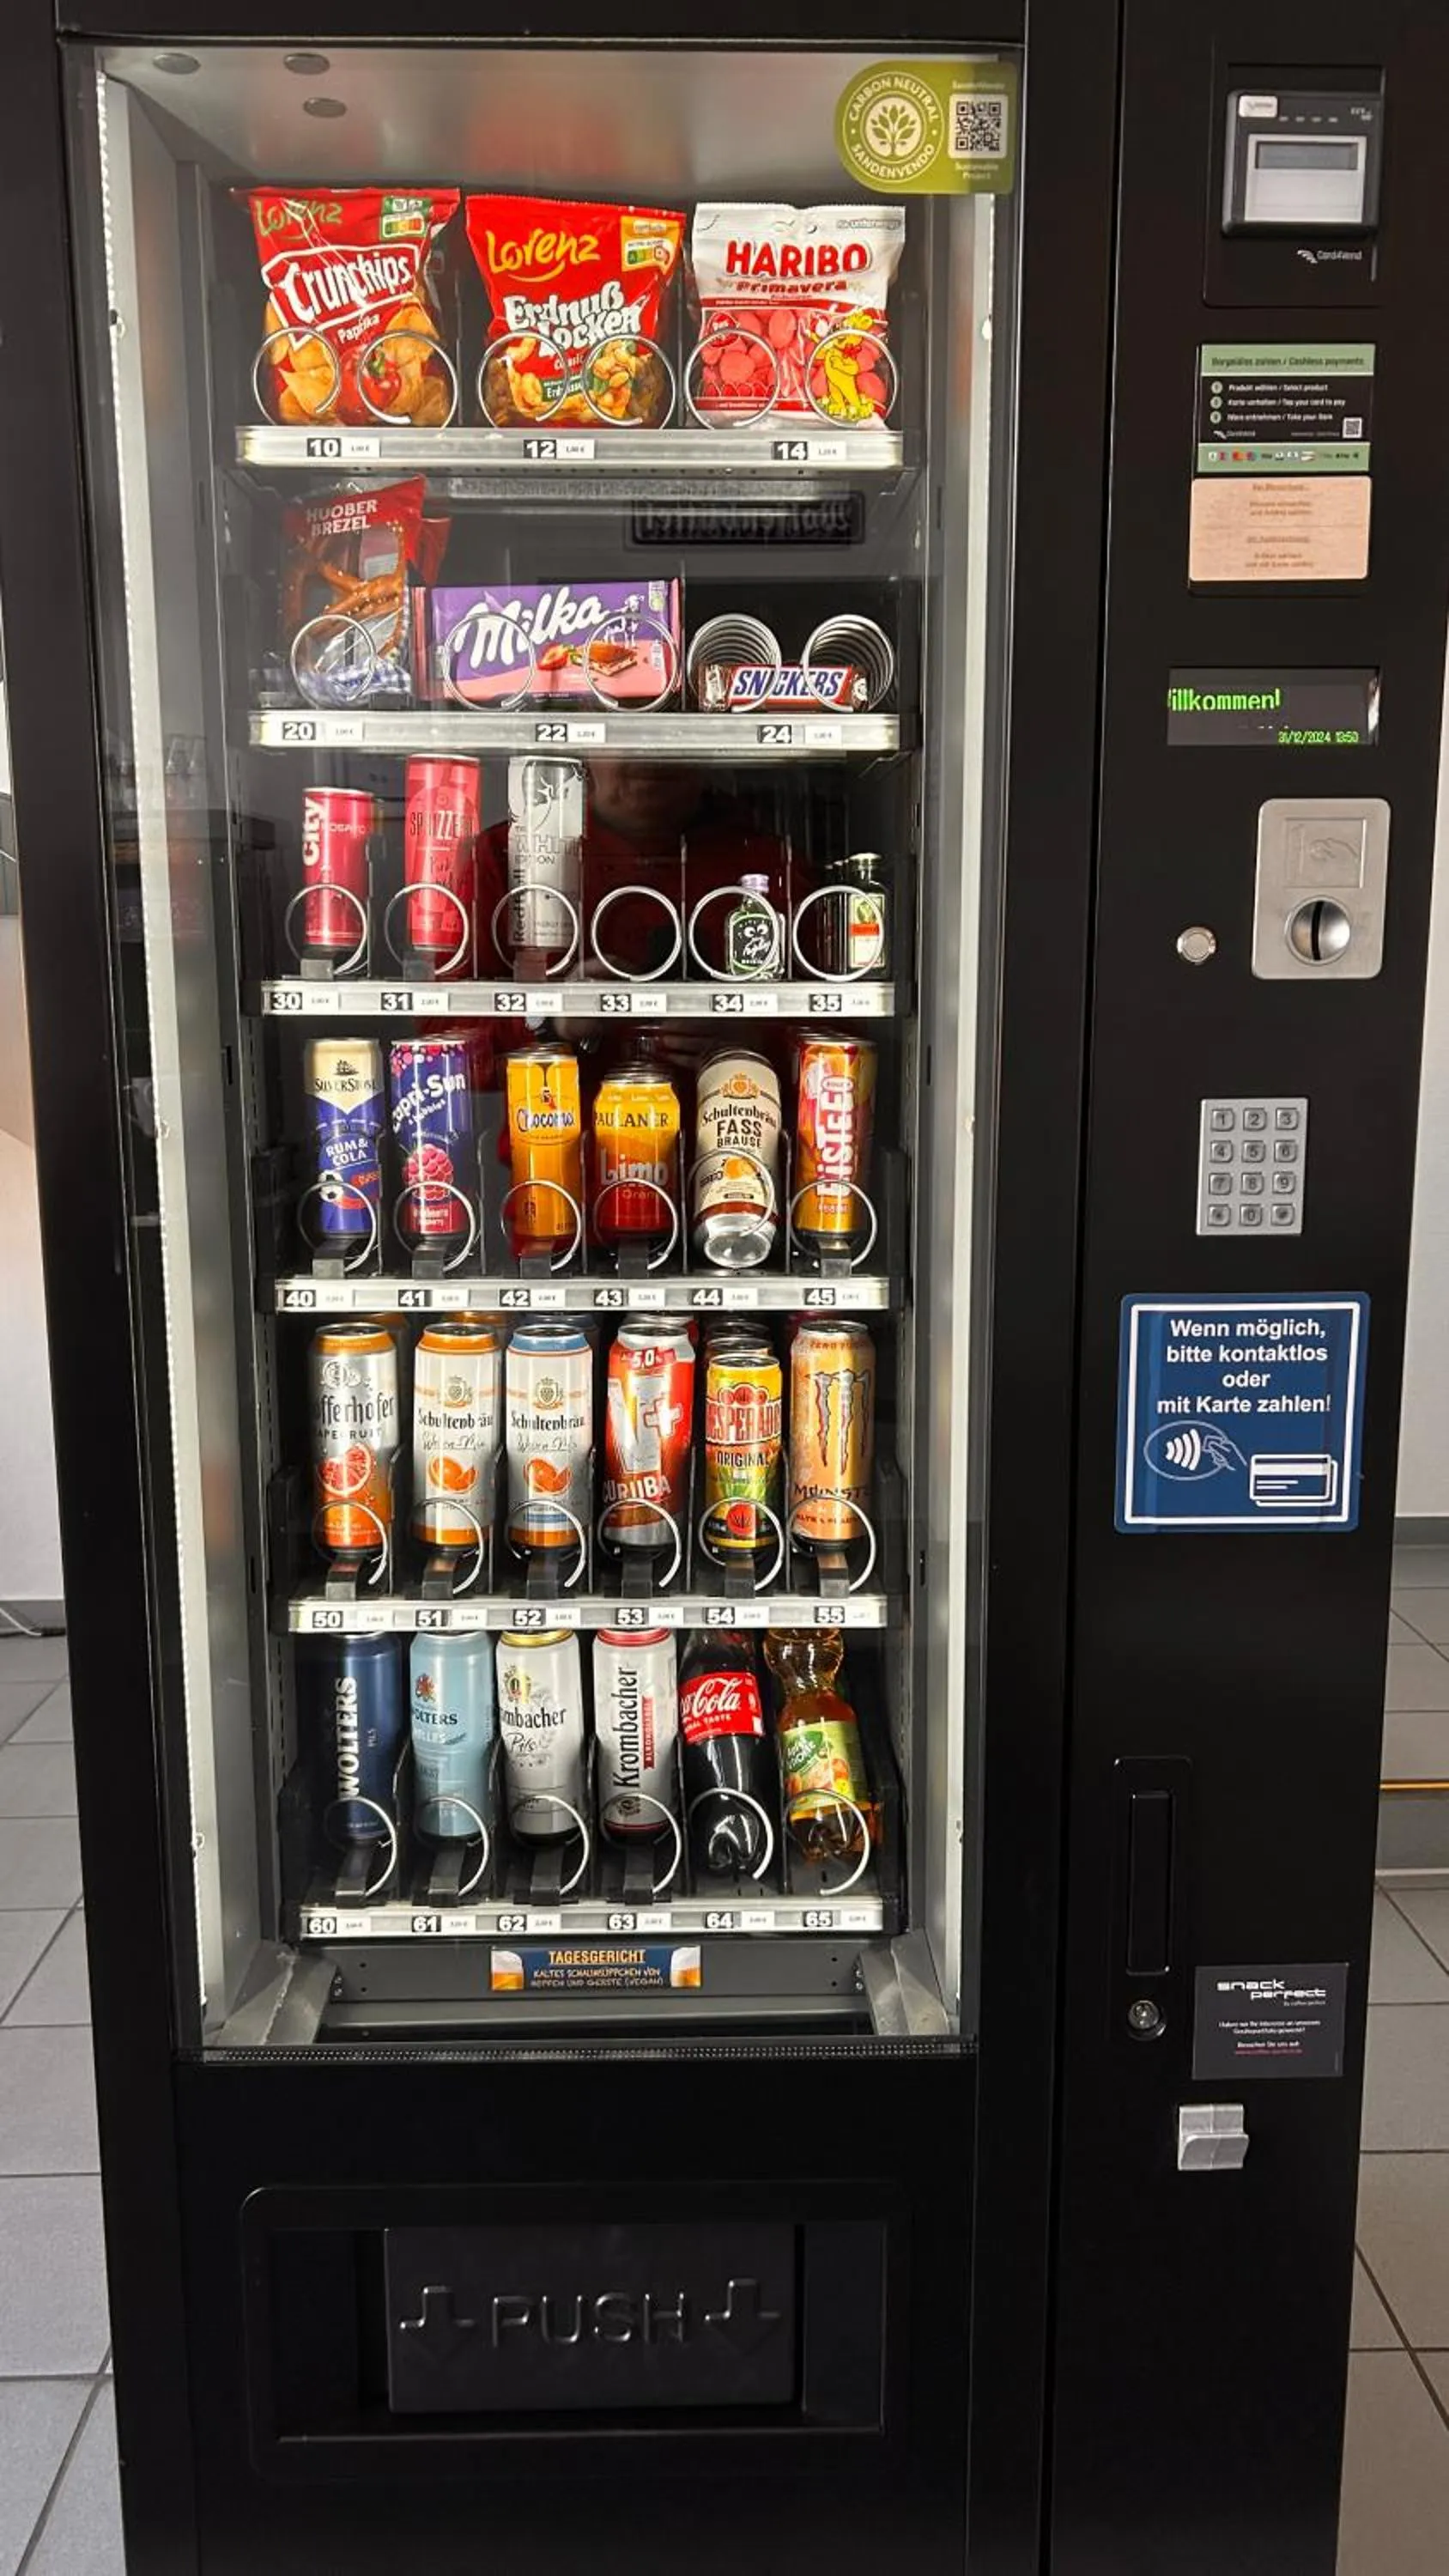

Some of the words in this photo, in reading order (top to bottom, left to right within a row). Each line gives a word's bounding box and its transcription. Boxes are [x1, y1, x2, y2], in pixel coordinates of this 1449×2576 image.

[849, 76, 892, 121] CARBON
[893, 76, 940, 123] NEUTRAL
[850, 144, 936, 179] SANDENVENDO
[485, 228, 600, 274] Lorenz
[725, 240, 870, 278] HARIBO
[279, 252, 410, 321] Crunchips
[736, 279, 847, 294] Primavera
[504, 281, 624, 329] Erdnuß
[309, 440, 338, 456] 10
[525, 440, 556, 459] 12
[777, 441, 806, 459] 14
[306, 499, 379, 522] HUOBER
[311, 515, 372, 537] BREZEL
[453, 587, 603, 669] Milka
[1167, 688, 1281, 711] illkommen!
[283, 723, 313, 739] 20
[537, 724, 567, 742] 22
[761, 726, 791, 743] 24
[303, 796, 324, 866] City
[272, 993, 300, 1010] 30
[383, 993, 411, 1010] 31
[496, 993, 524, 1011] 32
[602, 995, 630, 1012] 33
[714, 995, 743, 1012] 34
[812, 994, 841, 1011] 35
[717, 1119, 762, 1137] FASS
[717, 1135, 762, 1148] BRAUSE
[332, 1150, 367, 1166] COLA
[286, 1291, 314, 1306] 40
[399, 1291, 427, 1306] 41
[500, 1291, 530, 1306] 42
[595, 1291, 622, 1306] 43
[692, 1289, 722, 1305] 44
[806, 1289, 835, 1305] 45
[1171, 1319, 1229, 1337] Wenn
[1236, 1318, 1326, 1340] möglich,
[1167, 1346, 1212, 1363] bitte
[1219, 1345, 1328, 1362] kontaktlos
[1222, 1370, 1270, 1388] oder
[1157, 1395, 1190, 1413] mit
[1196, 1395, 1252, 1413] Karte
[1257, 1394, 1331, 1413] zahlen!
[716, 1450, 770, 1467] ORIGINAL
[314, 1611, 342, 1628] 50
[417, 1610, 446, 1626] 51
[514, 1610, 543, 1625] 52
[617, 1608, 643, 1624] 53
[706, 1608, 734, 1625] 54
[816, 1607, 843, 1624] 55
[500, 1706, 567, 1728] mbacher
[610, 1667, 640, 1788] Krombacher
[335, 1676, 360, 1798] WOLTERS
[308, 1917, 336, 1933] 60
[414, 1916, 440, 1932] 61
[498, 1915, 525, 1931] 62
[609, 1914, 635, 1929] 63
[706, 1913, 733, 1929] 64
[805, 1911, 832, 1927] 65
[548, 1949, 646, 1965] TAGESGERICHT
[1216, 1978, 1286, 1991] snack
[1250, 1989, 1326, 2001] perfect
[492, 2292, 685, 2348] PUSH
